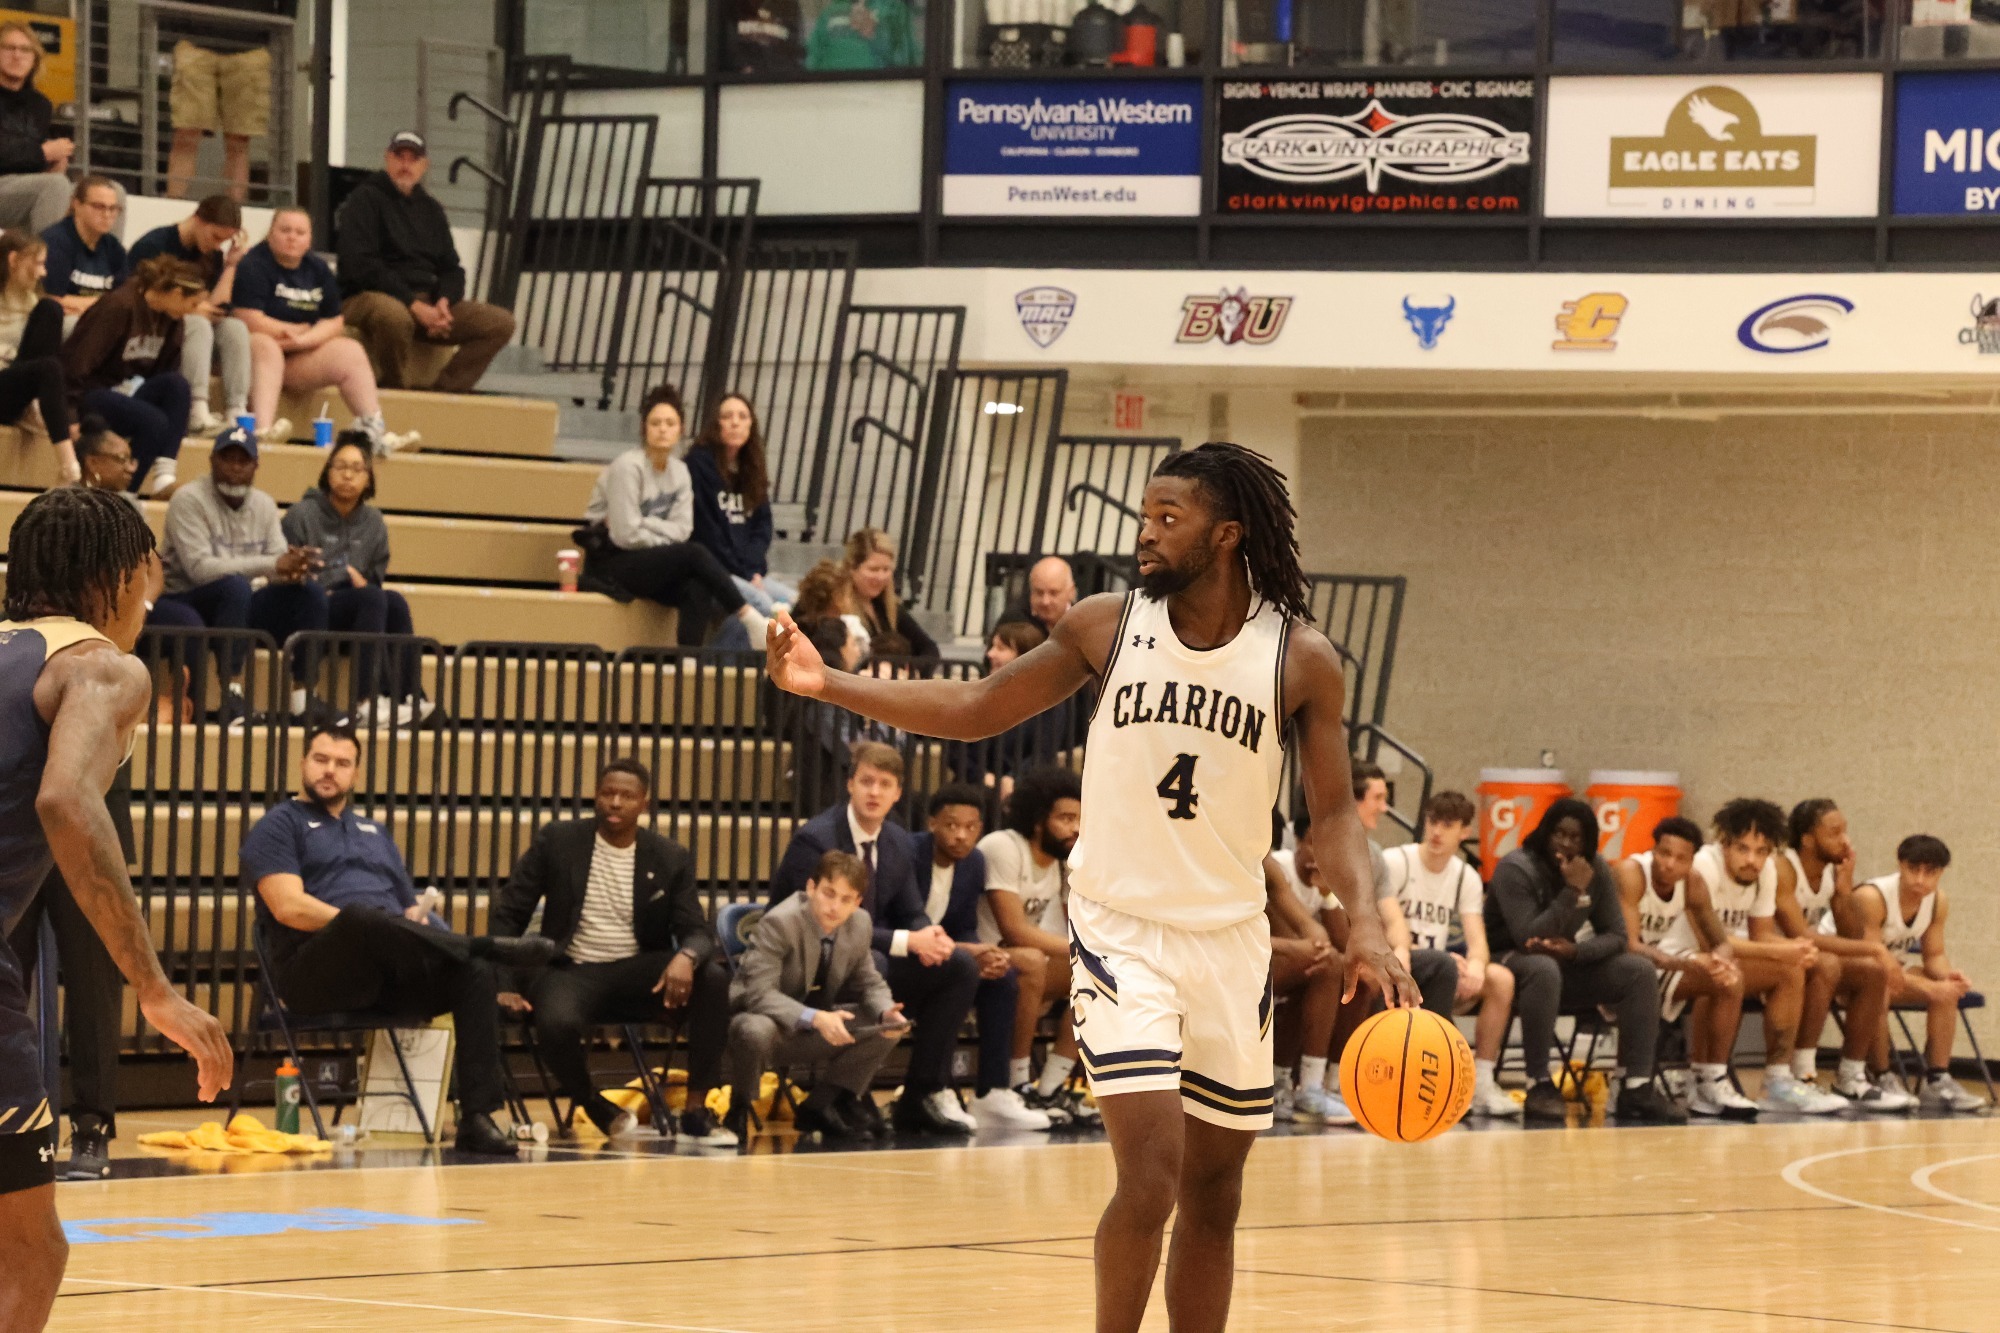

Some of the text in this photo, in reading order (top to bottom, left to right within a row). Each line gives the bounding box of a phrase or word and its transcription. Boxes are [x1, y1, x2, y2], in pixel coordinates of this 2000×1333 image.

[1439, 81, 1472, 98] CNC
[958, 98, 1192, 130] Pennsylvania Western
[1030, 124, 1117, 141] UNIVERSITY
[1226, 138, 1523, 158] CLARK VINYL GRAPHICS
[1623, 149, 1800, 172] EAGLE EATS
[1008, 186, 1136, 202] PennWest.edu
[1228, 194, 1519, 213] clarkvinylgraphics.com
[1662, 197, 1756, 210] DINING
[1965, 186, 2000, 210] BY
[1113, 681, 1267, 754] CLARION
[1156, 752, 1201, 820] 4
